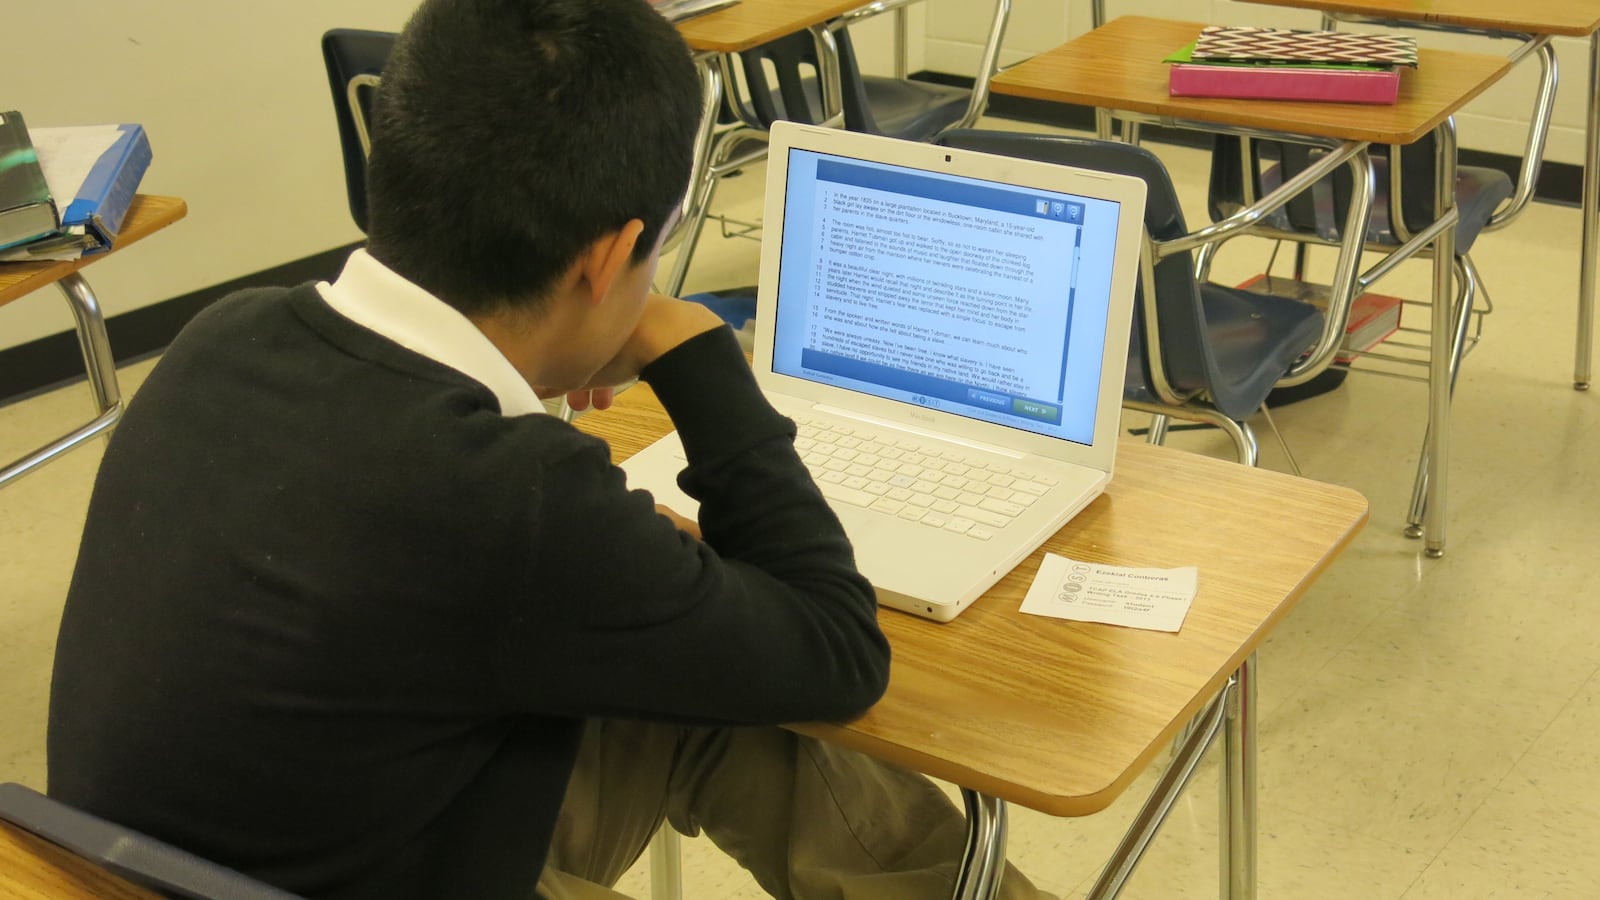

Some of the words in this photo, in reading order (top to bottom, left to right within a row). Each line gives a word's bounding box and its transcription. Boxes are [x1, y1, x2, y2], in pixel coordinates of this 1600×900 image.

[884, 200, 897, 208] large
[897, 203, 922, 212] plantation
[922, 207, 941, 215] located
[1014, 230, 1032, 238] shared
[829, 246, 847, 255] bumper
[851, 229, 867, 238] Harriet
[868, 232, 888, 241] Tubman
[962, 250, 984, 260] doorway
[830, 239, 844, 248] heavy
[885, 251, 906, 259] mansion
[964, 266, 992, 276] celebrating
[1002, 272, 1022, 281] harvest
[854, 237, 873, 246] listened
[939, 252, 959, 262] laughter
[971, 258, 988, 267] floated
[989, 262, 1003, 270] down
[1004, 265, 1024, 274] through
[1004, 251, 1027, 261] sleeping
[847, 263, 867, 272] beautiful
[906, 275, 925, 283] millions
[931, 280, 953, 290] twinkling
[1014, 296, 1029, 305] Many
[852, 271, 869, 279] Harriet
[932, 287, 954, 296] describe
[975, 295, 993, 305] turning
[825, 293, 842, 303] slavery
[826, 280, 846, 288] studded
[846, 284, 866, 293] heavens
[877, 290, 897, 299] stripped
[897, 295, 910, 303] away
[945, 303, 956, 312] kept
[1000, 314, 1013, 324] body
[959, 300, 980, 308] reached
[980, 303, 995, 311] down
[918, 306, 939, 314] replaced
[955, 313, 971, 321] single
[994, 321, 1013, 330] escape
[912, 325, 929, 333] Harriet
[972, 337, 985, 345] learn
[912, 332, 926, 341] being
[822, 333, 844, 343] hundreds
[850, 340, 870, 348] escaped
[957, 363, 973, 372] willing
[846, 332, 862, 340] always
[959, 356, 977, 366] slavery
[858, 349, 885, 360] opportunity
[910, 359, 926, 368] friends
[979, 394, 1004, 405] PREVIOUS
[1023, 404, 1038, 413] NEXT
[1128, 572, 1169, 582] Contreras
